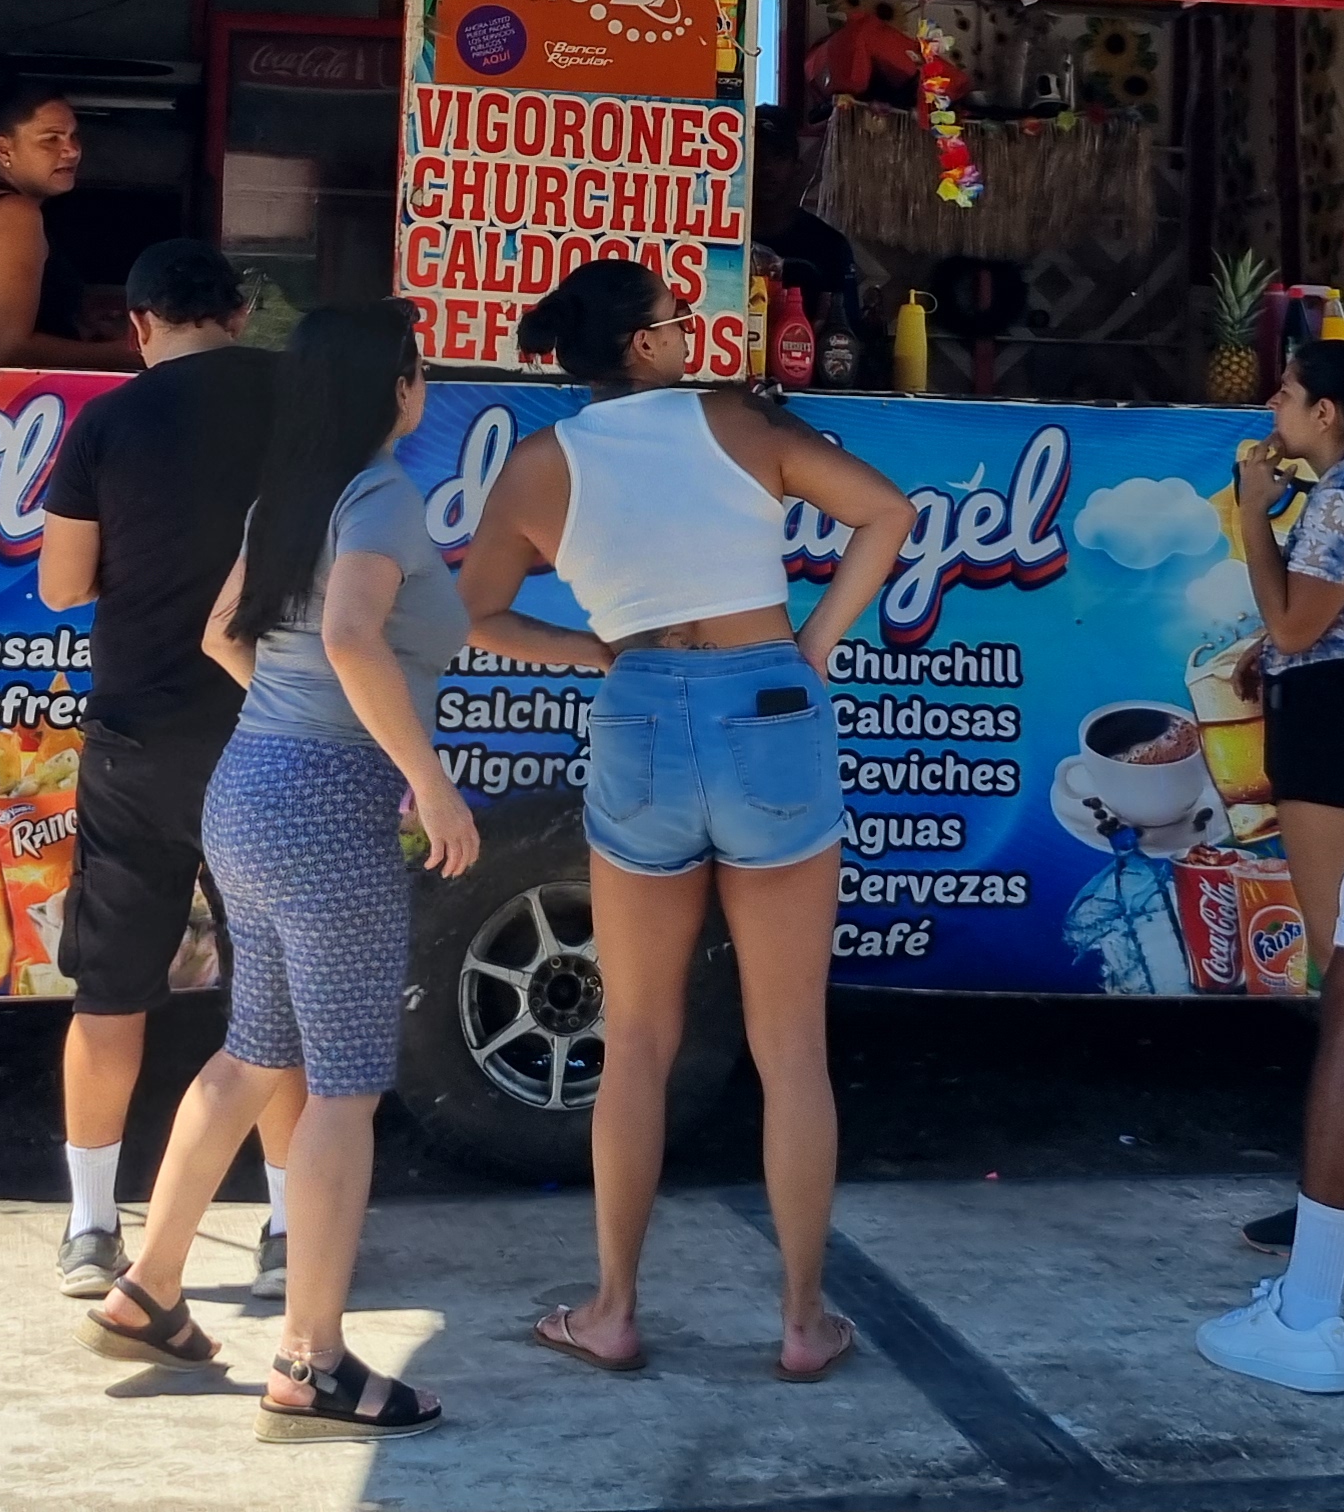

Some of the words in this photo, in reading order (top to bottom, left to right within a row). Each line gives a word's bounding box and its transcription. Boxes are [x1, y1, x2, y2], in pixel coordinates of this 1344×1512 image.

[546, 53, 614, 68] Popular
[553, 41, 608, 55] Banco
[415, 87, 742, 172] VIGORONES
[411, 156, 743, 239] CHURCHILL
[827, 644, 1019, 683] Churchill
[835, 698, 1017, 738] Caldosas
[837, 753, 1016, 792] Ceviches
[836, 867, 1027, 904] Cervezas
[831, 919, 932, 958] Café
[1252, 921, 1303, 964] Fanta
